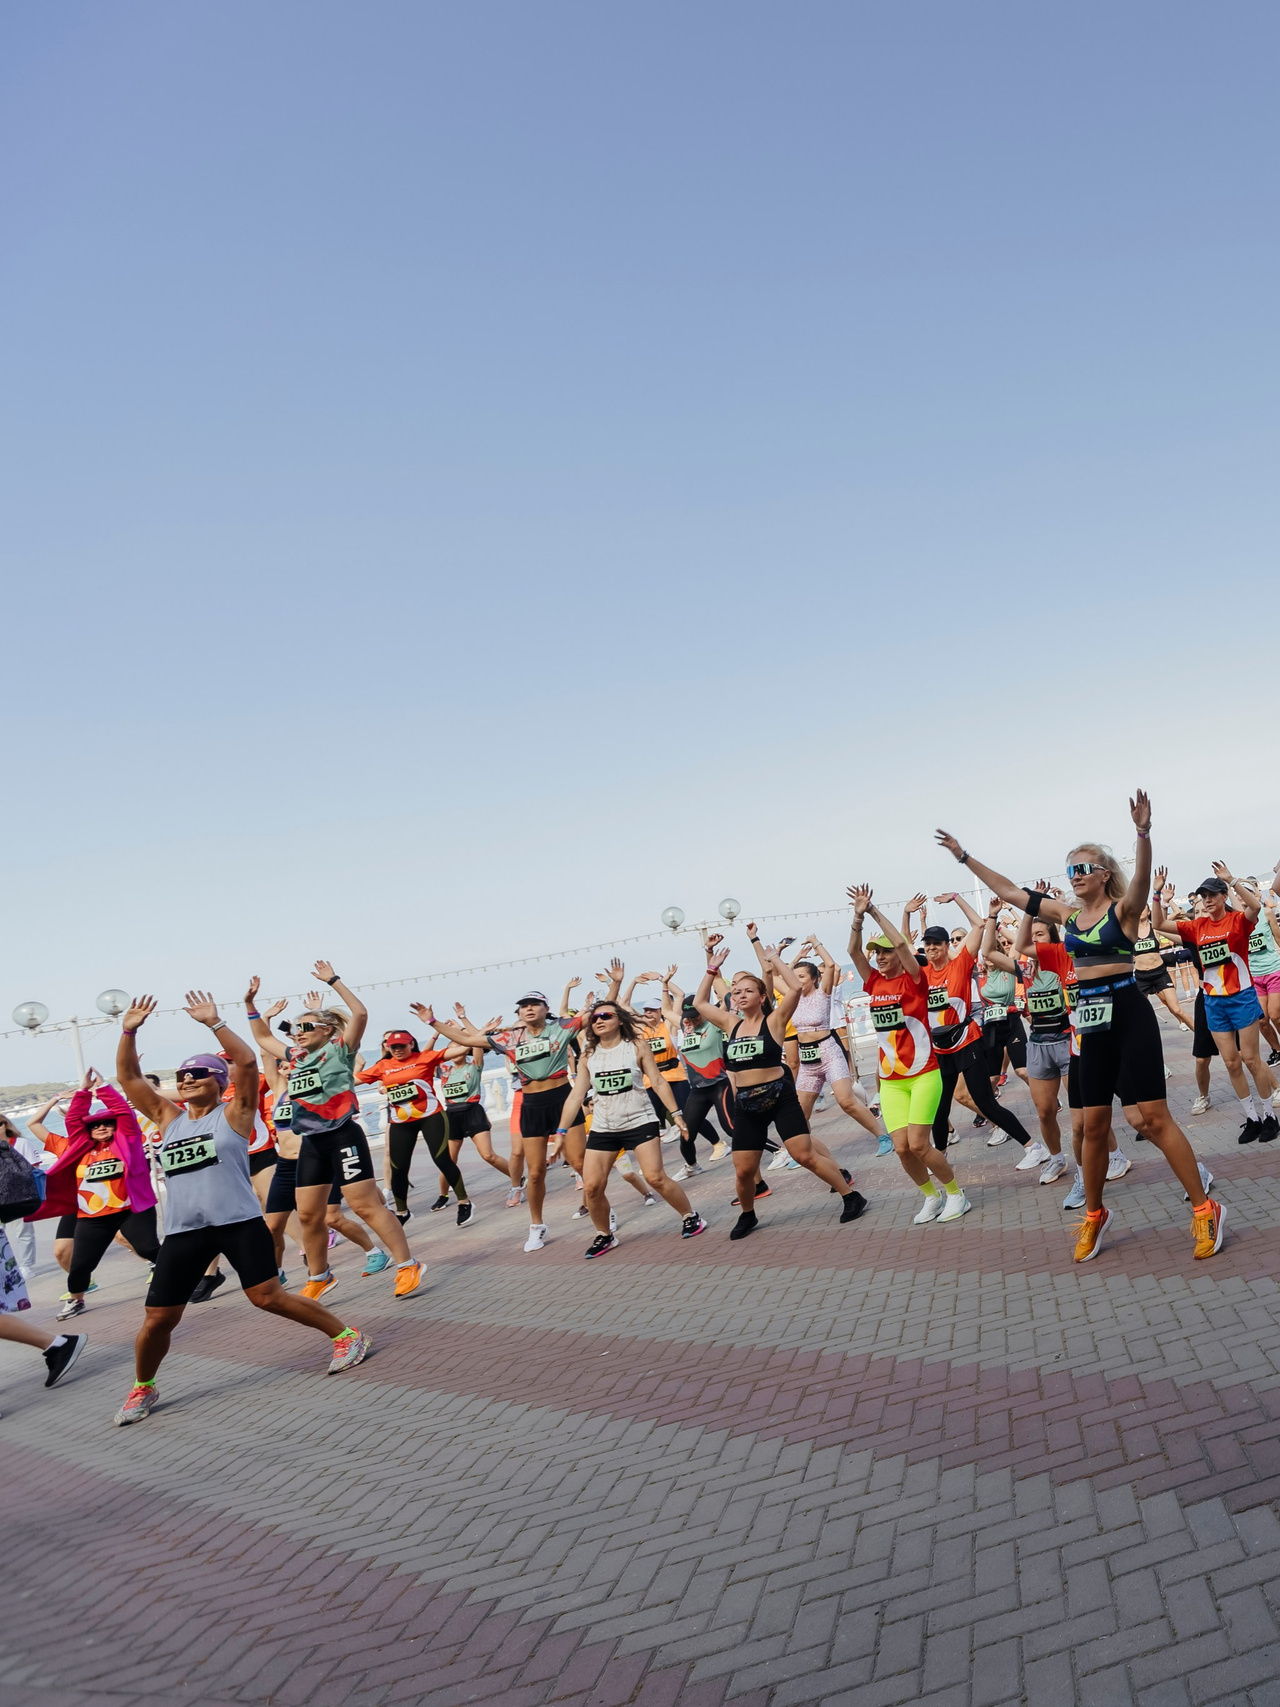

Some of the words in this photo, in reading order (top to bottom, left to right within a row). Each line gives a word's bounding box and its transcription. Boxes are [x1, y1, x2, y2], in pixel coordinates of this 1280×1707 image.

[1137, 941, 1152, 949] 7195
[1249, 939, 1263, 948] 160
[1202, 948, 1226, 961] 7204
[875, 994, 901, 1003] МАГНИТ
[928, 995, 945, 1005] 096
[1032, 998, 1055, 1009] 7112
[874, 1012, 898, 1024] 7097
[1079, 1007, 1105, 1023] 7037
[519, 1043, 545, 1056] 7300
[732, 1043, 757, 1055] 7175
[292, 1078, 315, 1092] 7276
[600, 1077, 626, 1089] 7157
[390, 1089, 414, 1100] 7094
[446, 1086, 464, 1096] 7265
[167, 1144, 207, 1166] 7234
[340, 1146, 362, 1181] FILA
[90, 1164, 117, 1176] 7257
